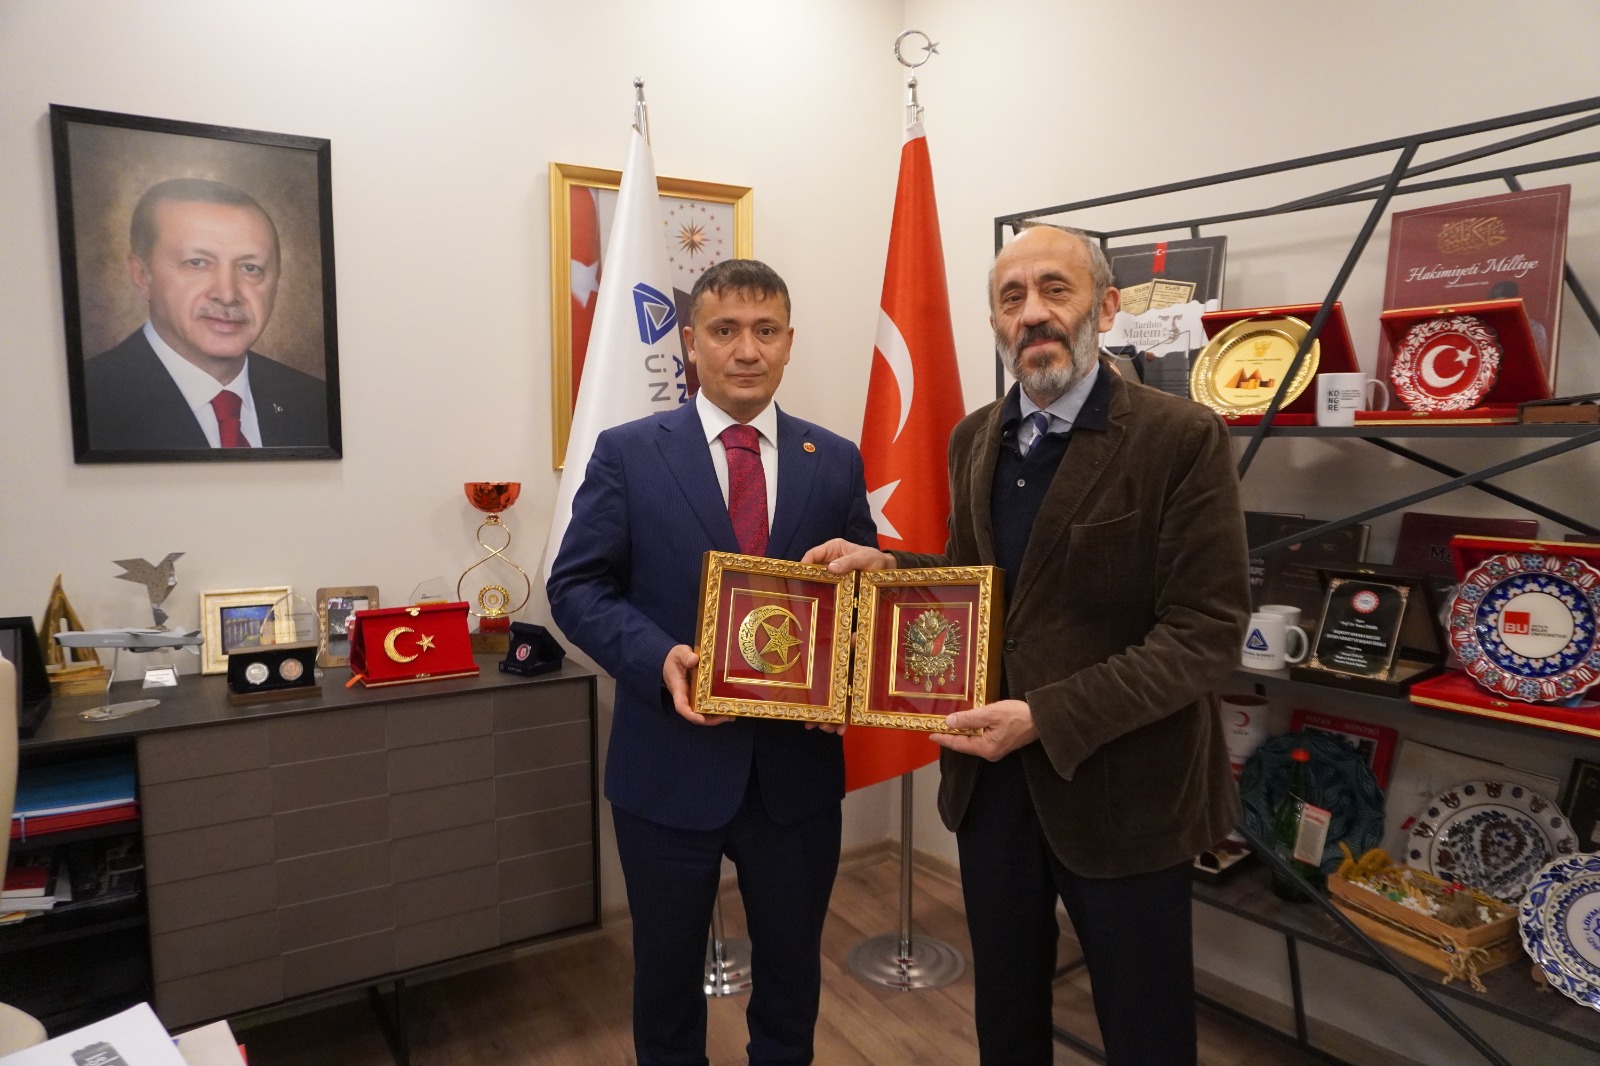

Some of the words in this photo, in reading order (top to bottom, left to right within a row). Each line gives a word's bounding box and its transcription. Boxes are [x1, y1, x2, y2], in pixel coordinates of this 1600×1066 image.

[1404, 263, 1481, 284] Hakimiyeti
[1481, 253, 1539, 278] Milliye
[1134, 321, 1162, 329] Tarihin
[1122, 328, 1161, 339] Matem
[644, 354, 672, 415] ÜN
[1504, 622, 1529, 634] BU
